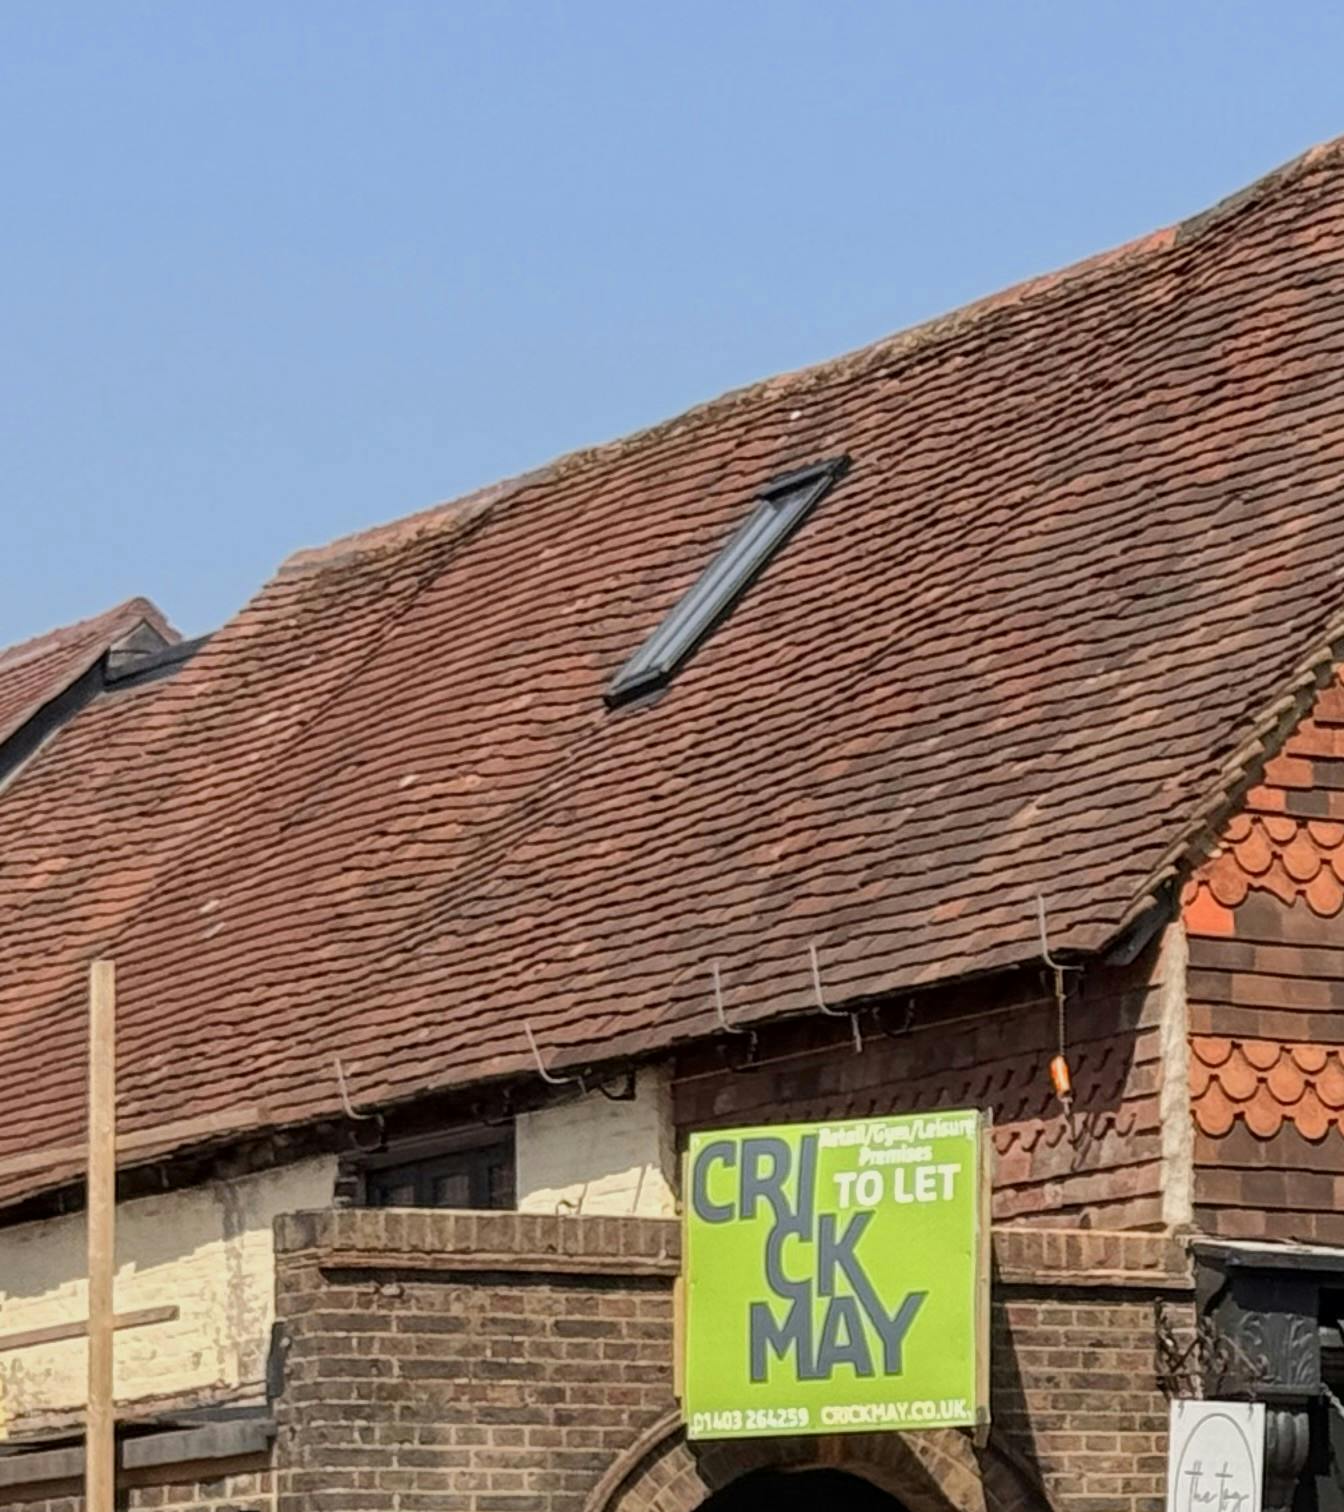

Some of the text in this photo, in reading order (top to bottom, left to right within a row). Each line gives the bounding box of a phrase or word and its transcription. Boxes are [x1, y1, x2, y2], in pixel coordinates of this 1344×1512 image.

[833, 1163, 962, 1209] TO LET
[745, 1407, 810, 1429] 264259
